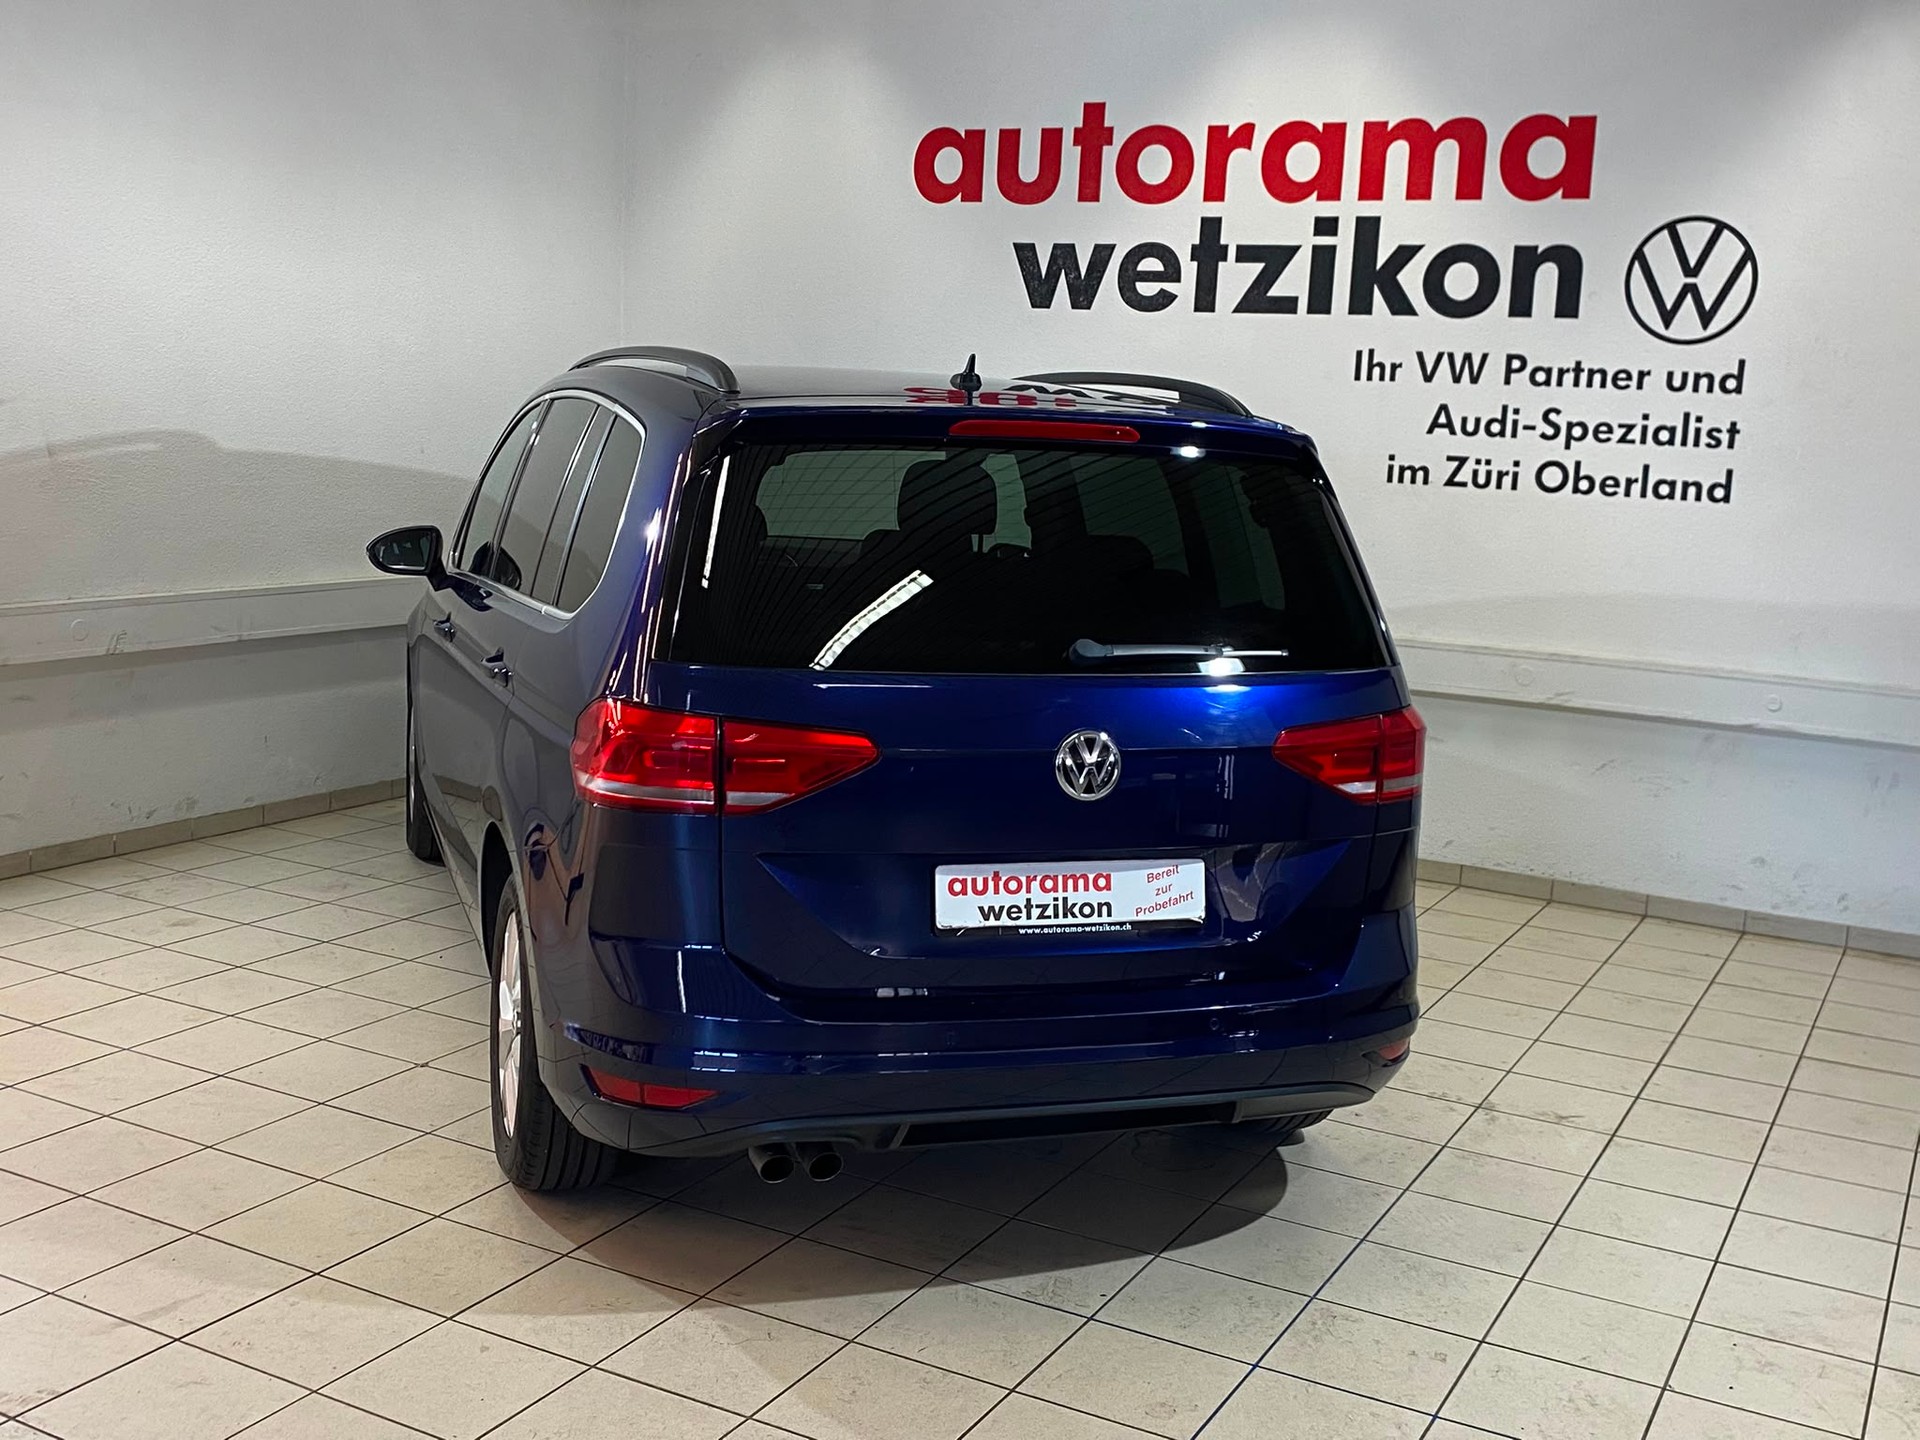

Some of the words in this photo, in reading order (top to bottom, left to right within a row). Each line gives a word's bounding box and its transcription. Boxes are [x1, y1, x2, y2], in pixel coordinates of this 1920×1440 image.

[913, 101, 1598, 206] autorama
[1012, 215, 1584, 320] wetzikon
[1625, 216, 1758, 345] VW
[1353, 348, 1403, 382] Ihr
[1415, 351, 1490, 385] VW
[1503, 353, 1652, 391] Partner
[1664, 358, 1746, 395] und
[1425, 403, 1741, 450] Audi-Spezialist
[1386, 454, 1431, 486] im
[1442, 455, 1521, 491] Züri
[1534, 460, 1734, 504] Oberland
[1055, 730, 1121, 801] VW
[947, 870, 1112, 897] autorama
[1146, 865, 1180, 884] Bereit
[1154, 882, 1174, 897] zur
[978, 897, 1113, 922] wetzikon
[1135, 890, 1195, 917] Probefahrt
[1018, 922, 1132, 935] www.autorama-wetzikon.ch
